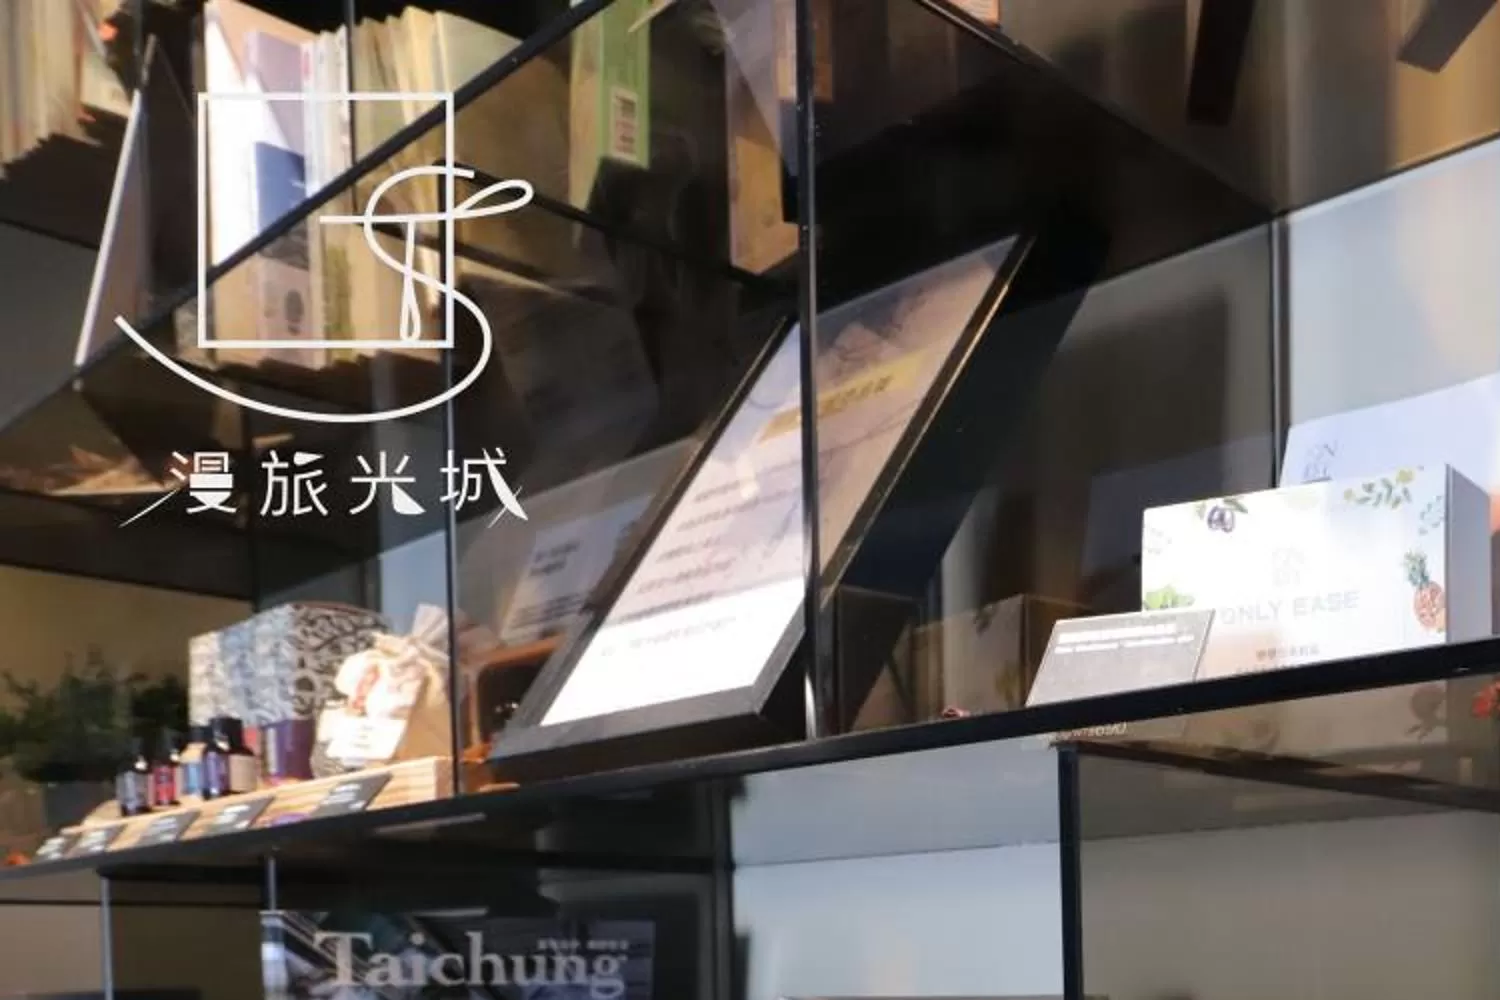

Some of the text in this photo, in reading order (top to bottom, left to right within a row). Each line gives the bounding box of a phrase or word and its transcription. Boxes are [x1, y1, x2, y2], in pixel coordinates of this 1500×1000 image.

[1220, 589, 1361, 626] ONLY EASE
[313, 931, 629, 999] Taichung
